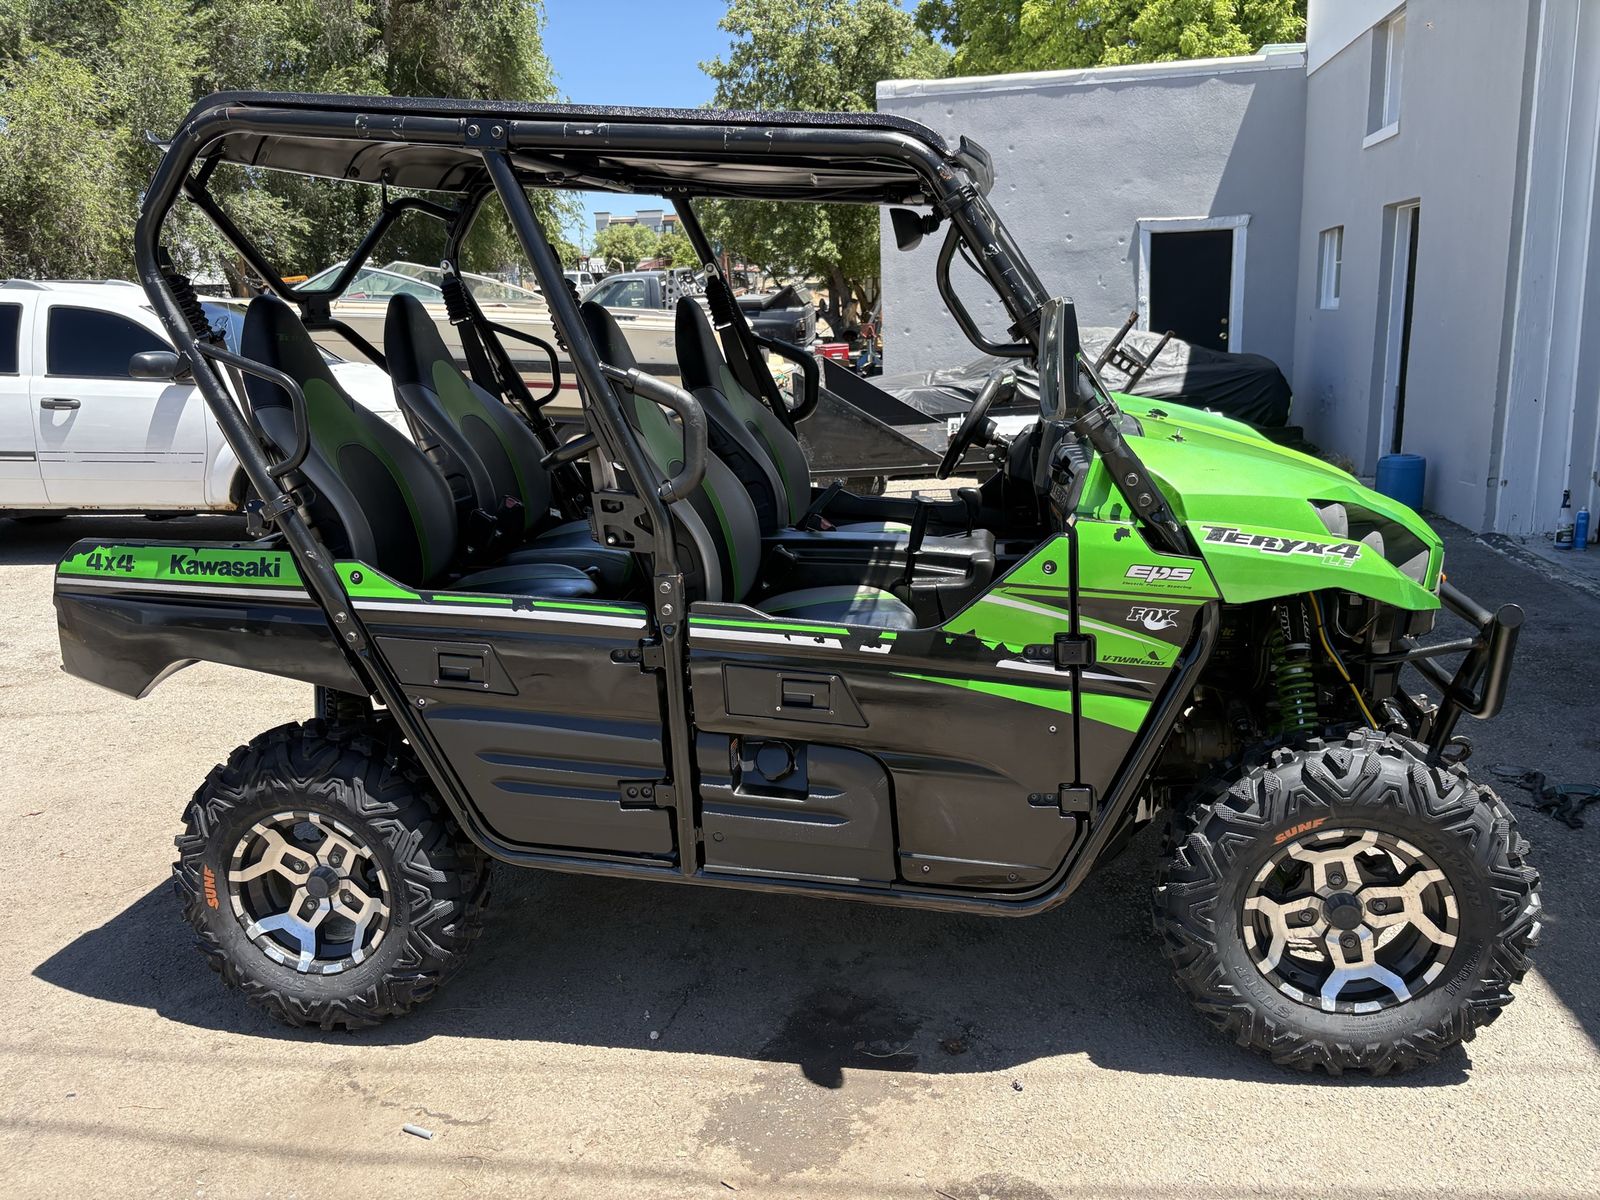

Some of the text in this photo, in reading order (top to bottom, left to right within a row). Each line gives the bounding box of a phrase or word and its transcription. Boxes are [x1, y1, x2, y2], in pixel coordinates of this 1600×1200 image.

[1200, 525, 1361, 557] TERYX4
[86, 552, 281, 578] 4x4 Kawasaki
[1321, 554, 1356, 568] LE
[1126, 606, 1180, 630] FOX
[1270, 815, 1331, 847] SUNF
[203, 863, 220, 910] SUNF
